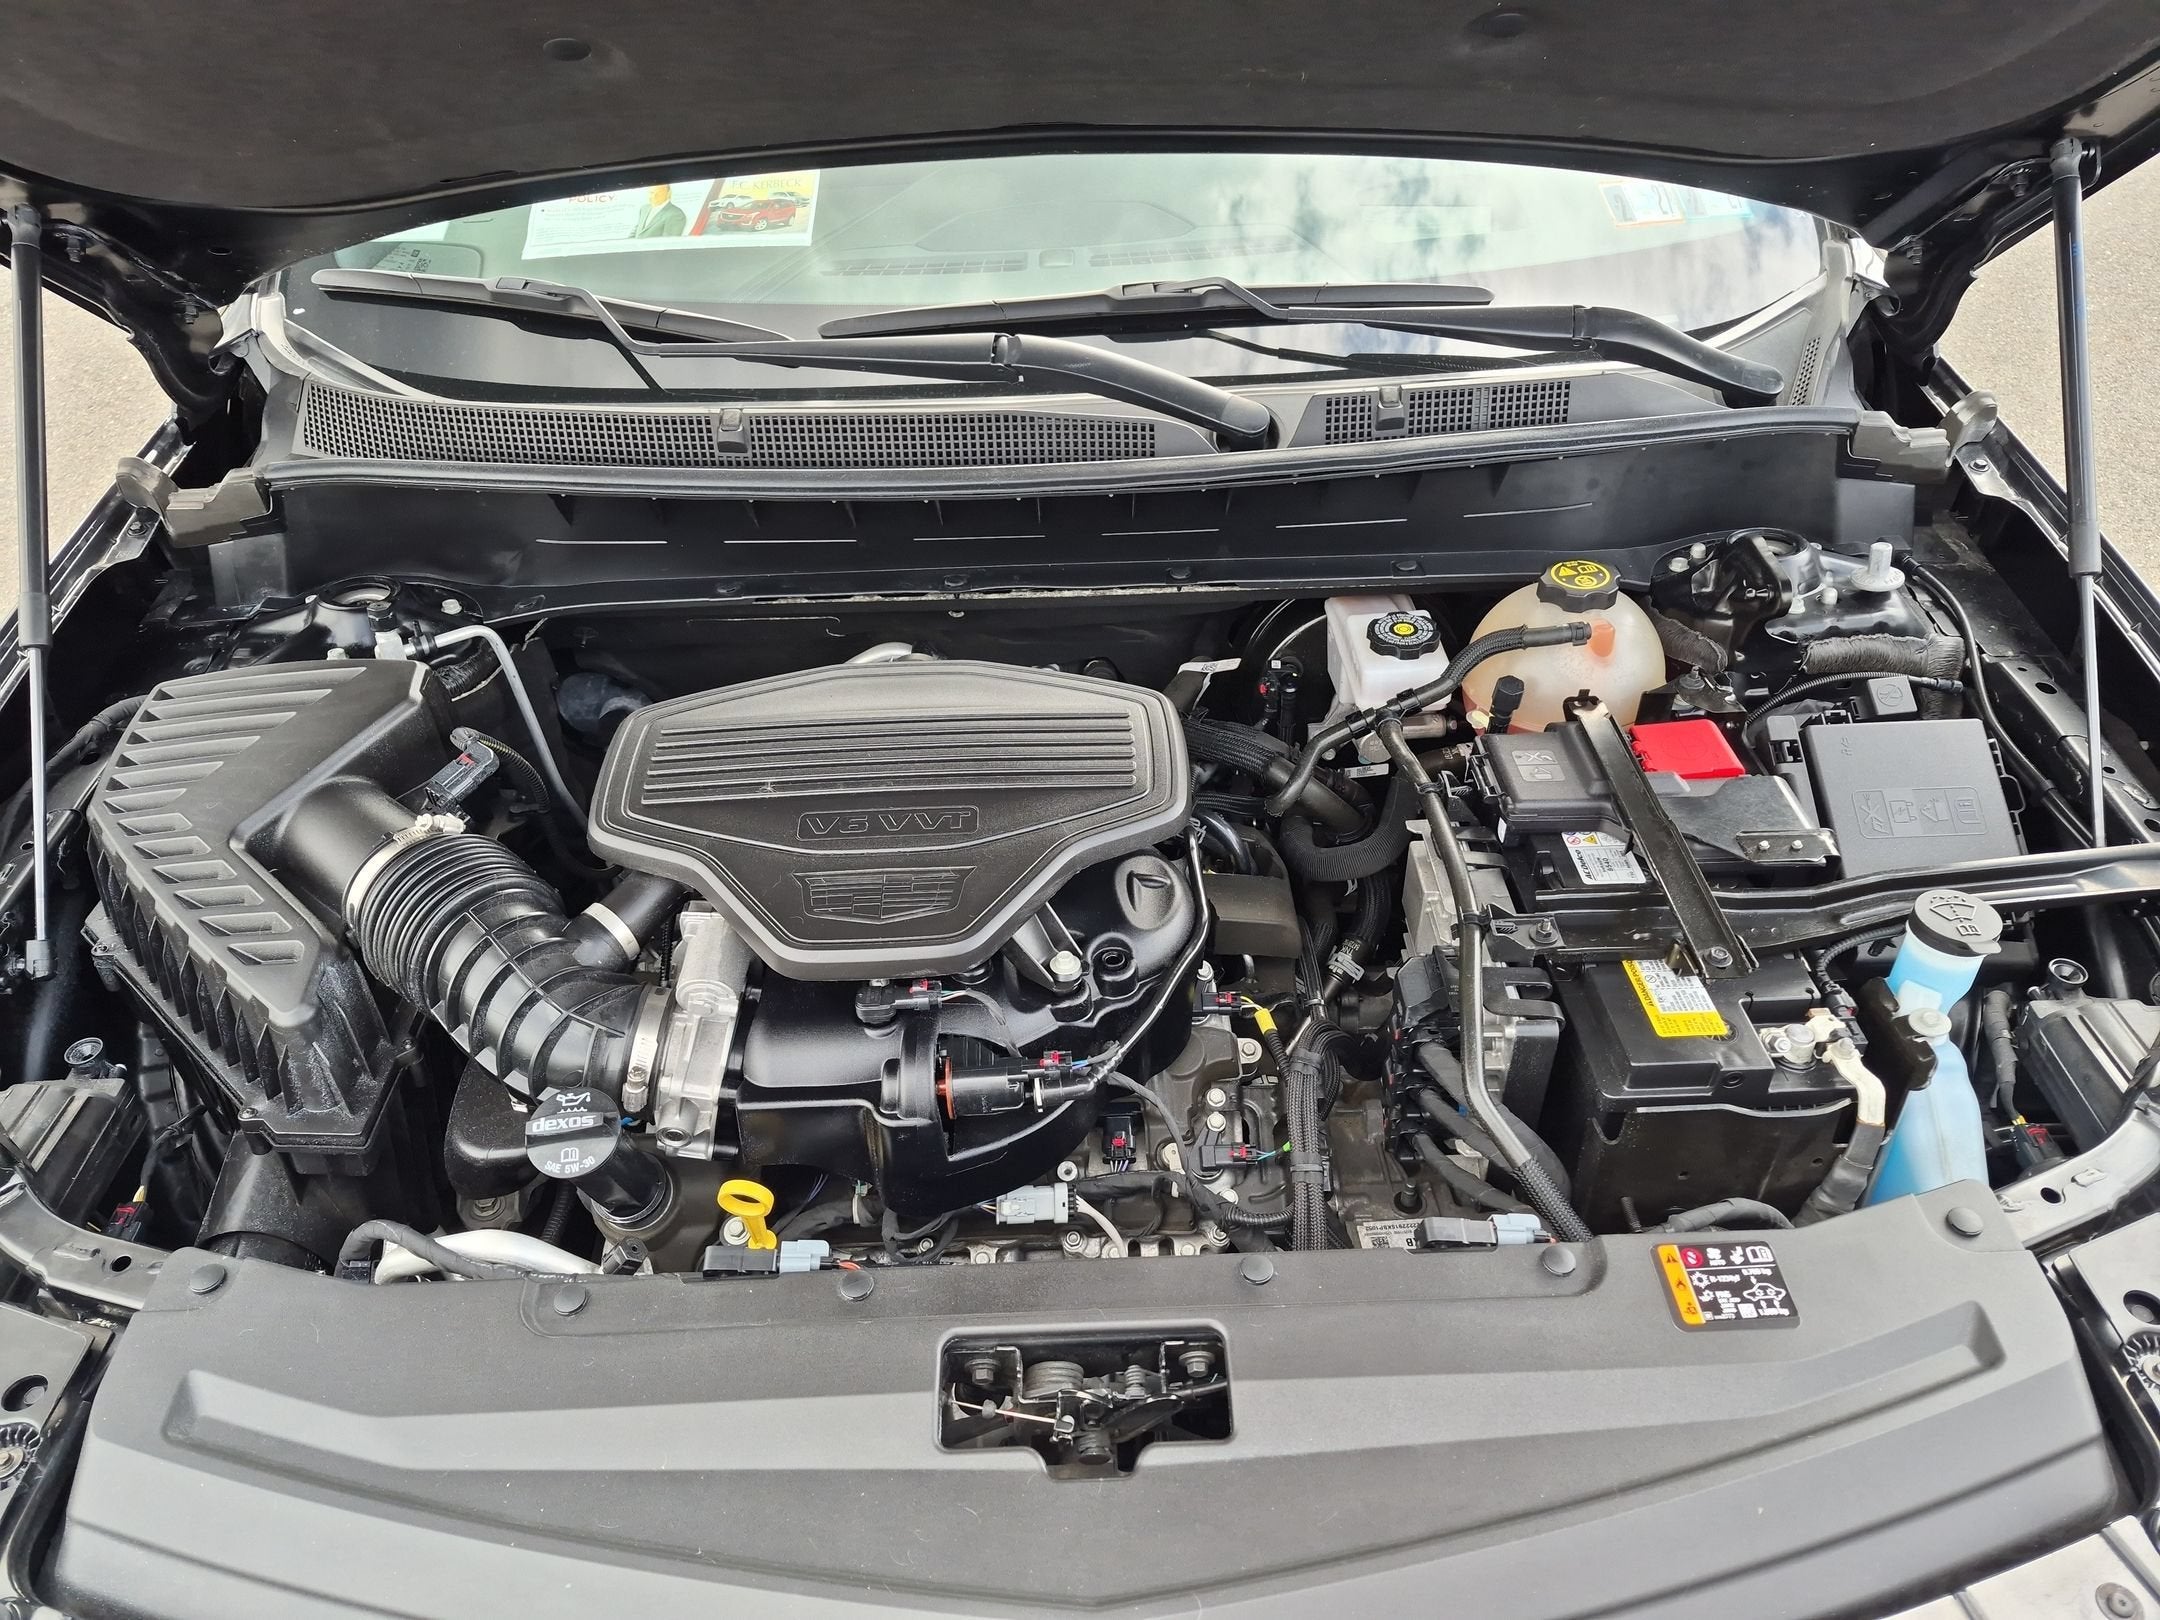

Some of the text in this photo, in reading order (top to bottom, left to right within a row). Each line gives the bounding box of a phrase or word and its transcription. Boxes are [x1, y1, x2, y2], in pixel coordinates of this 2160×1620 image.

[878, 811, 971, 832] VVT
[532, 1114, 597, 1133] dexos
[544, 1155, 596, 1174] SAE 5W-30
